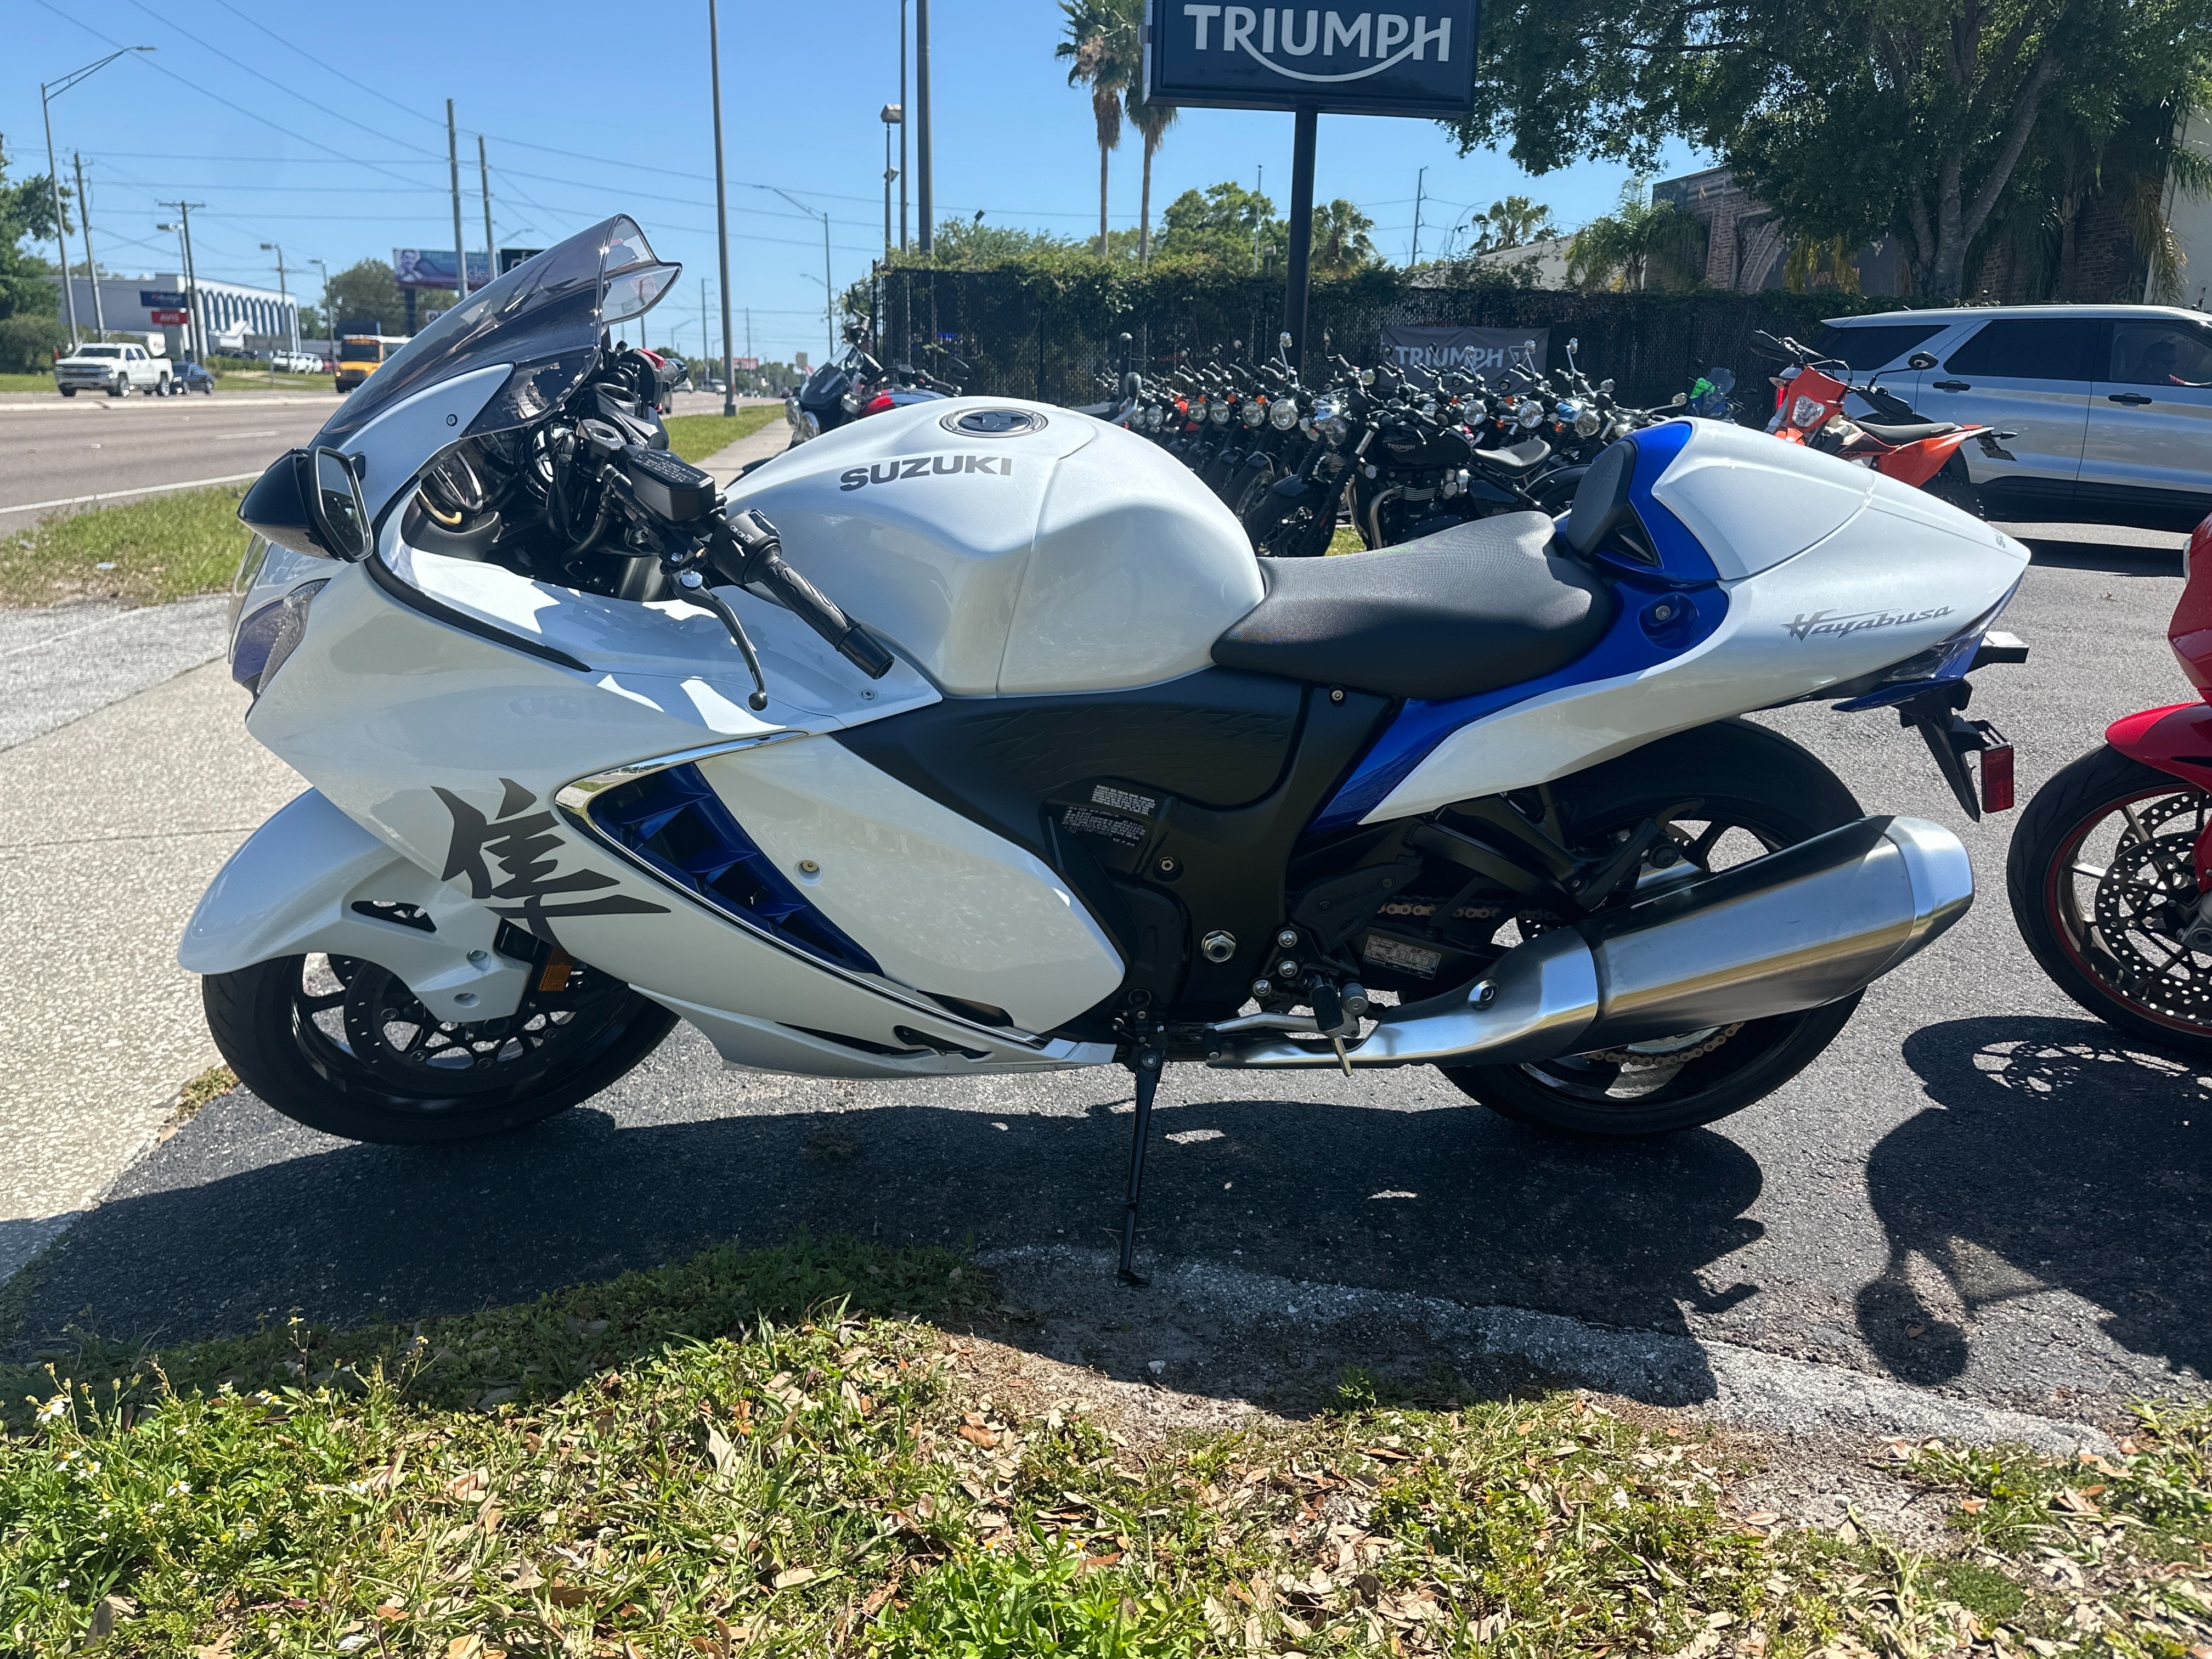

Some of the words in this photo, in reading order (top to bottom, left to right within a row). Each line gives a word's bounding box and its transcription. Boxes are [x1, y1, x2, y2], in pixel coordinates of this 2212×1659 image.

[1184, 4, 1452, 82] TRIUMPH
[160, 313, 180, 323] AVIS
[1395, 345, 1504, 371] TRIUMPH
[1387, 443, 1415, 452] TRIUMPH
[839, 455, 1012, 492] SUZUKI
[1781, 606, 1956, 641] Hayabusa
[430, 777, 672, 955] 隼
